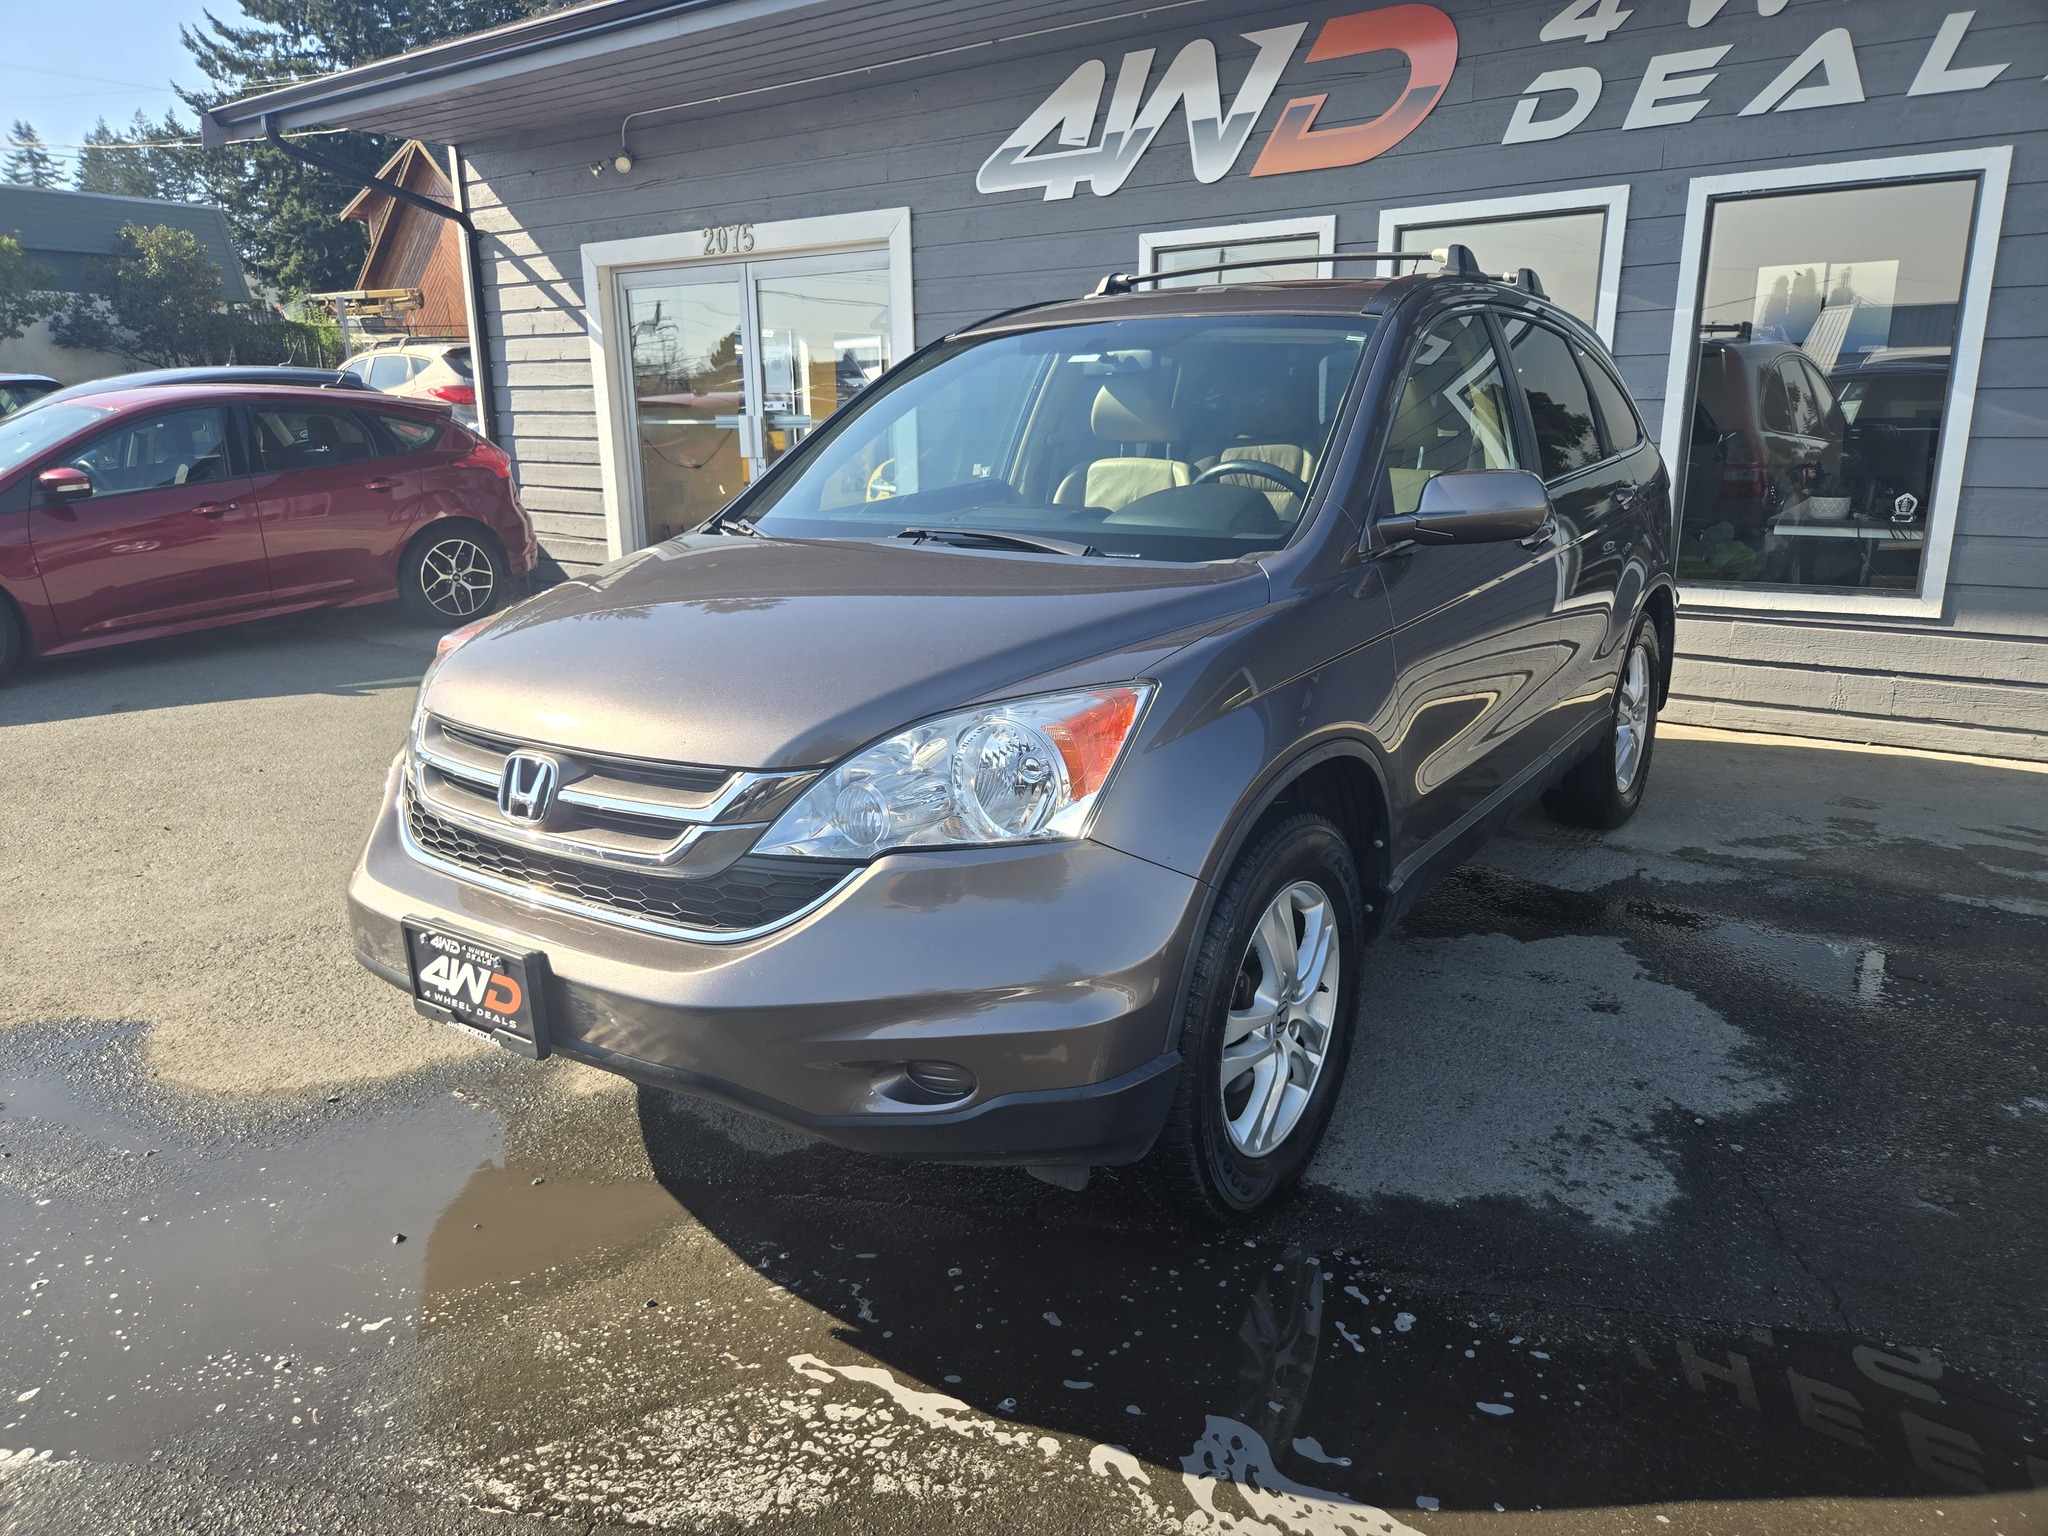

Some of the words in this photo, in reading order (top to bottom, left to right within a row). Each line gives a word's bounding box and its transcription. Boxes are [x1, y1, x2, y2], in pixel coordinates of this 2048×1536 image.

[1501, 10, 2048, 145] DEAL
[976, 3, 1459, 201] 4WD
[702, 224, 754, 255] 2075
[430, 935, 460, 954] 4WD
[468, 946, 495, 960] WHEEL
[420, 955, 522, 1014] 4WD
[424, 990, 431, 998] 4
[434, 992, 472, 1012] WHEEL
[476, 1008, 517, 1029] DEALS
